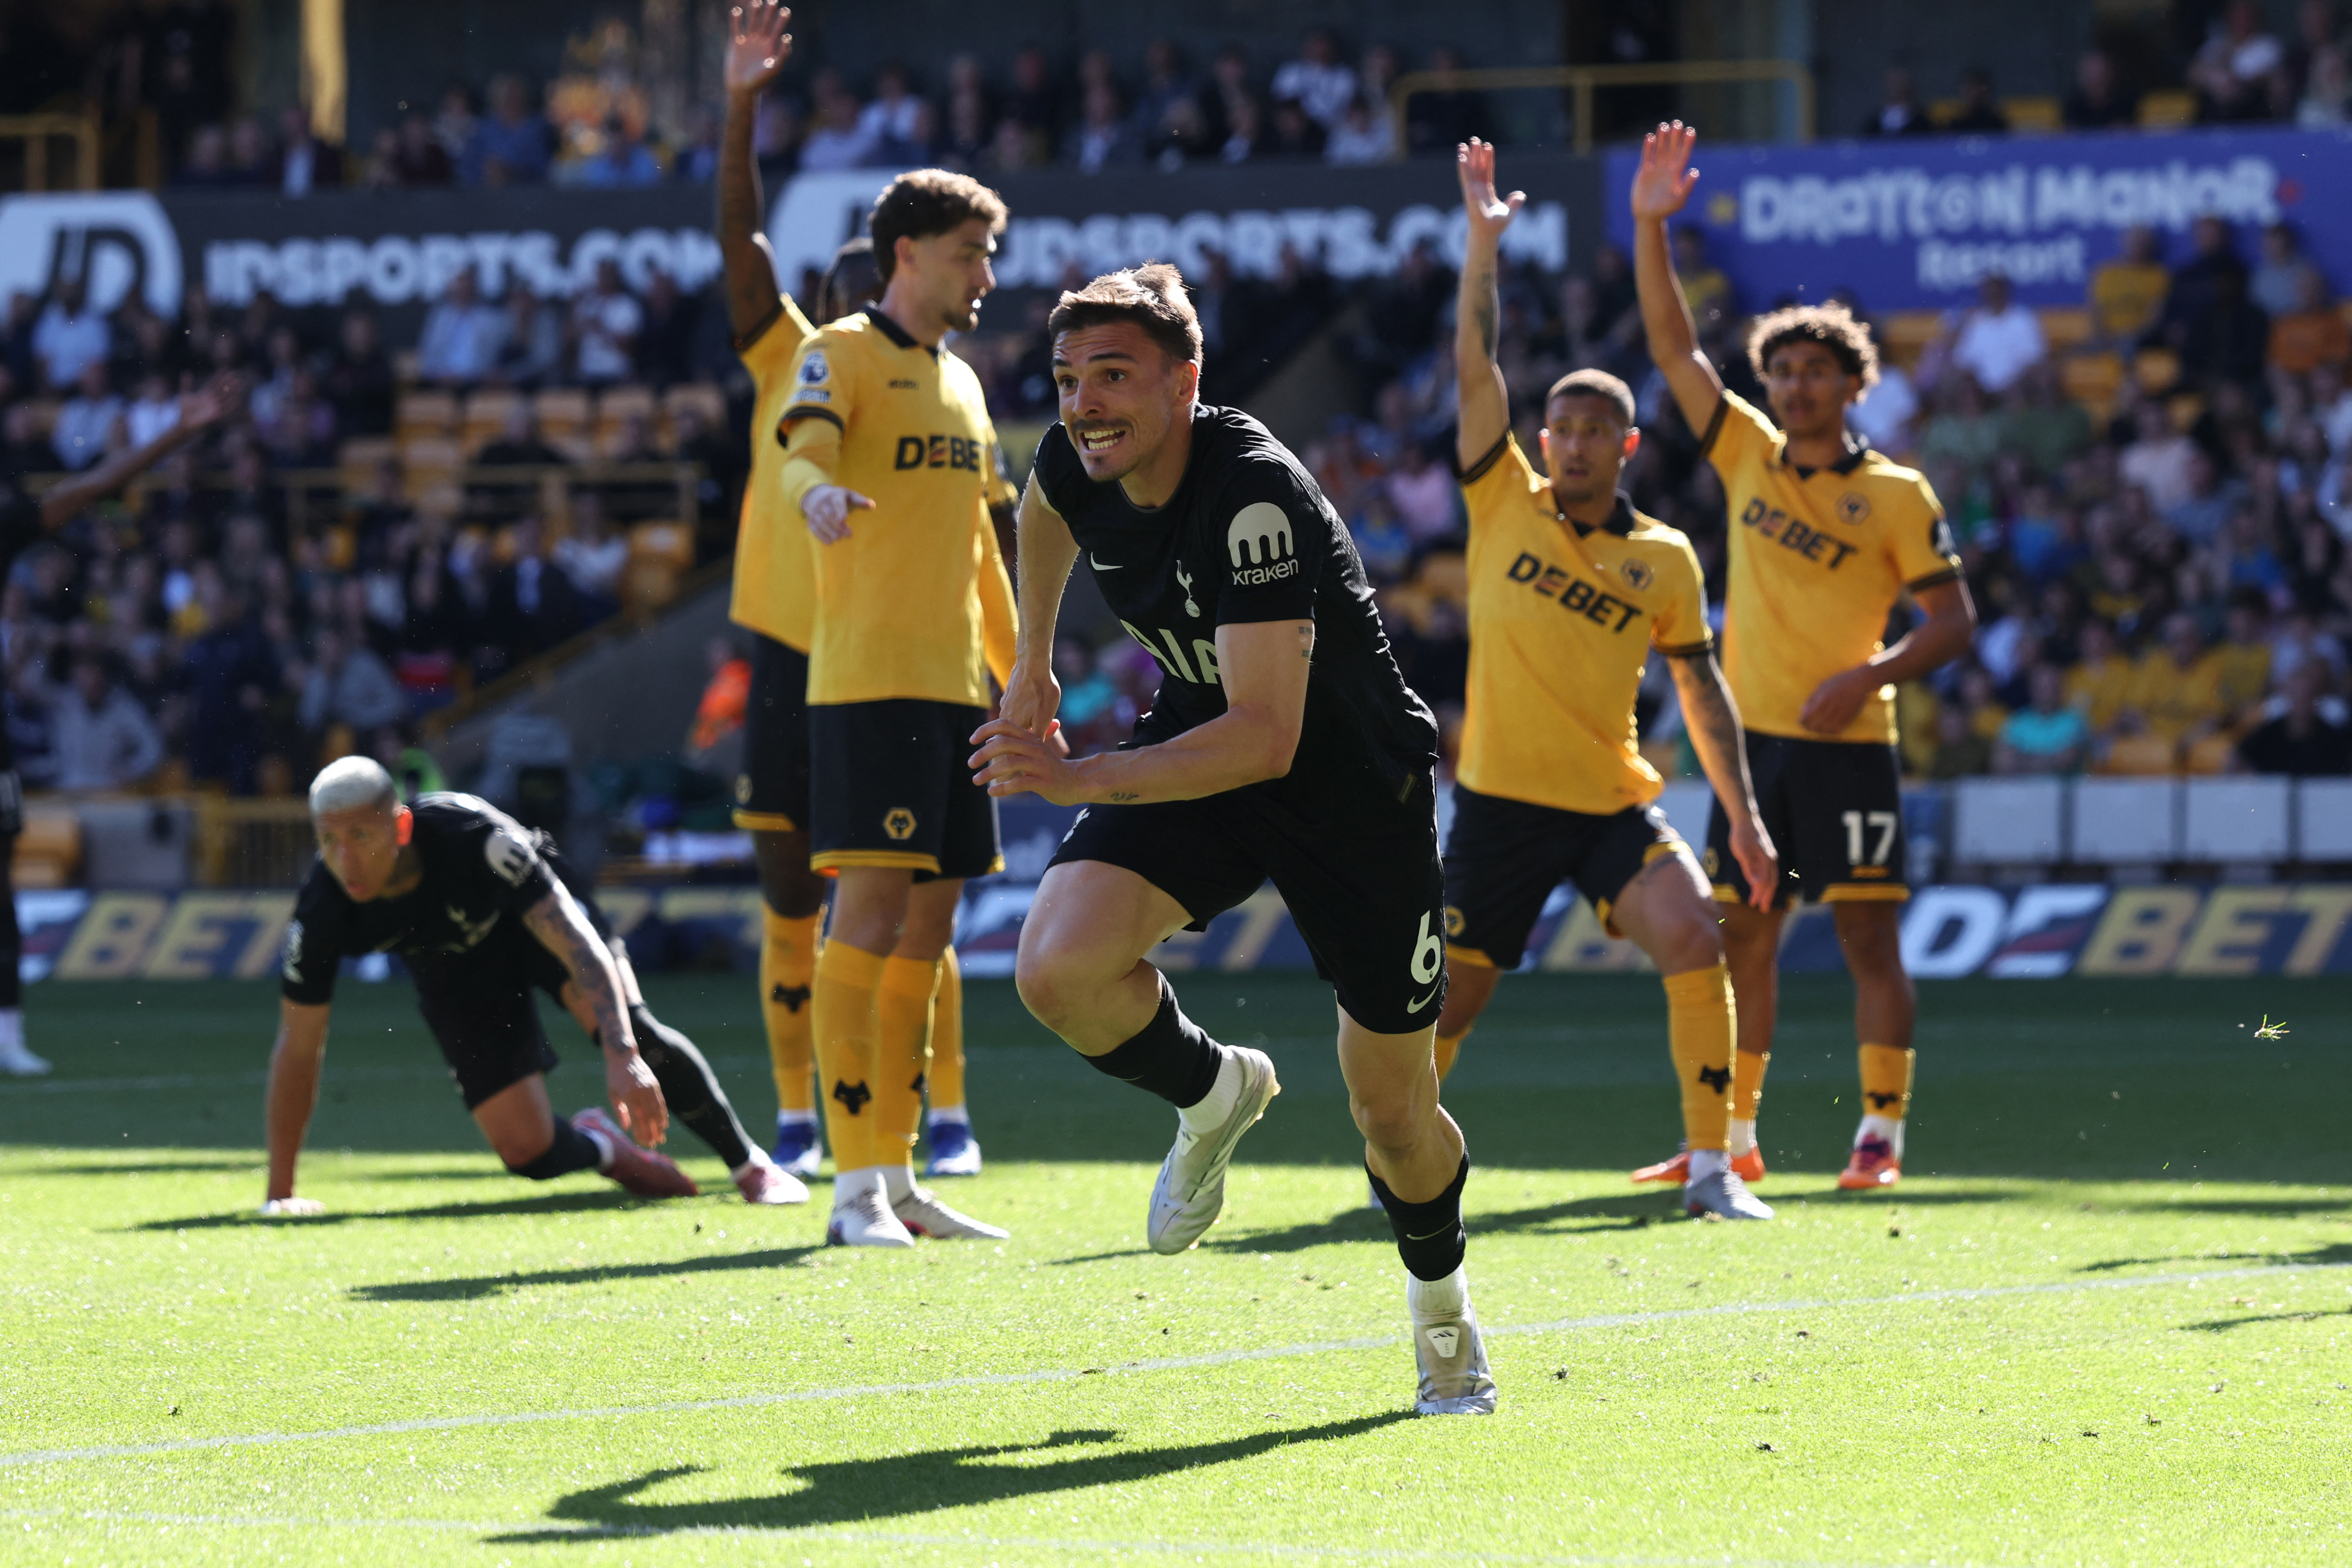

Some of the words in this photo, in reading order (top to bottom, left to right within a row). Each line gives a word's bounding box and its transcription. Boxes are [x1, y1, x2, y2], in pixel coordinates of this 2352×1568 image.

[895, 435, 986, 471] DEBE
[1741, 496, 1858, 572] DEBET
[1232, 559, 1298, 585] kraken
[1506, 550, 1643, 634] DEBET
[1841, 810, 1897, 866] 17
[1411, 910, 1441, 984] 6
